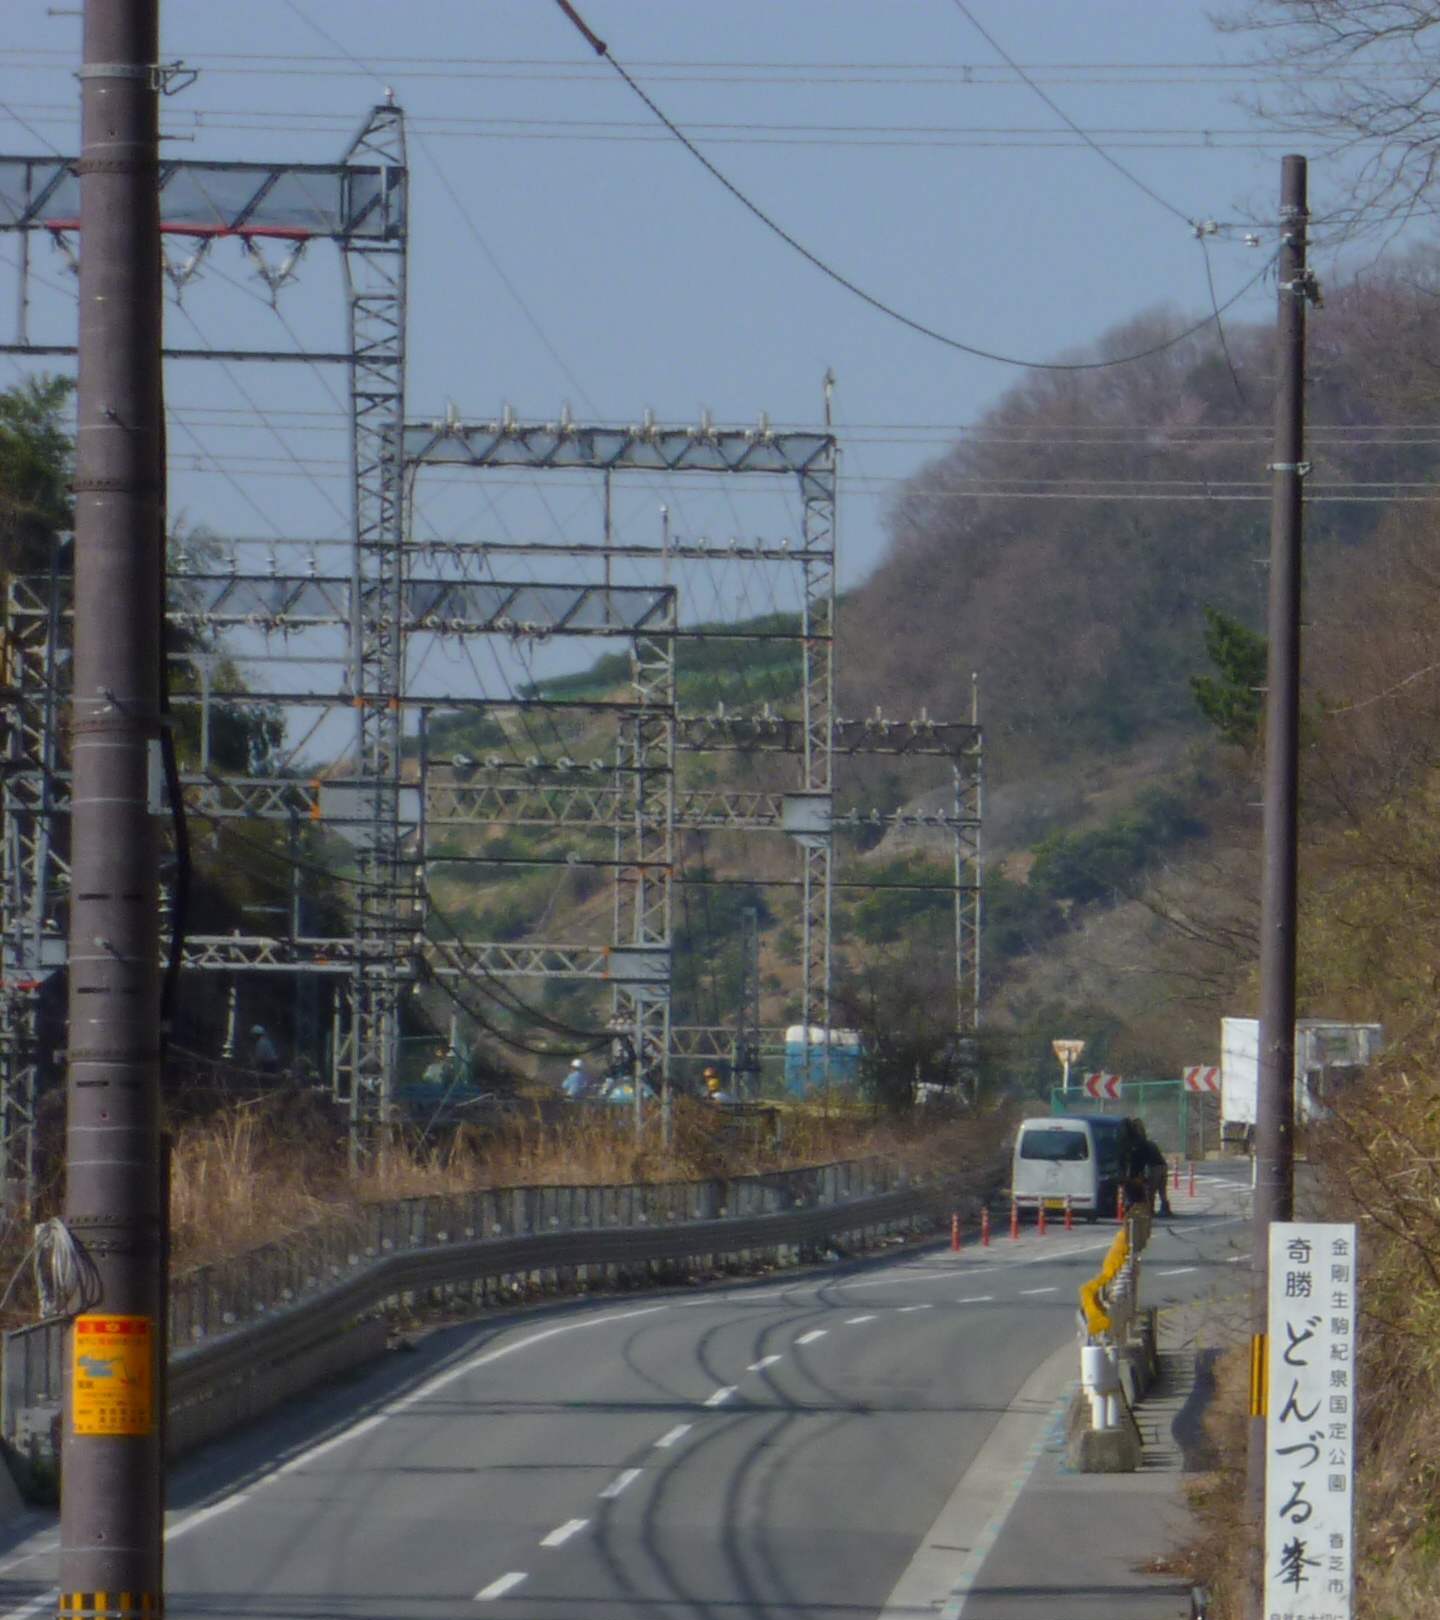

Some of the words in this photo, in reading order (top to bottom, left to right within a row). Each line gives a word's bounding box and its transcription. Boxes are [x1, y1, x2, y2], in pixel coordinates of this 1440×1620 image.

[1285, 1237, 1312, 1299] 奇勝
[1328, 1238, 1349, 1492] 金剛生駒紀泉国定公園
[1274, 1316, 1324, 1593] どんづる峯
[1328, 1532, 1345, 1594] 香芝市
